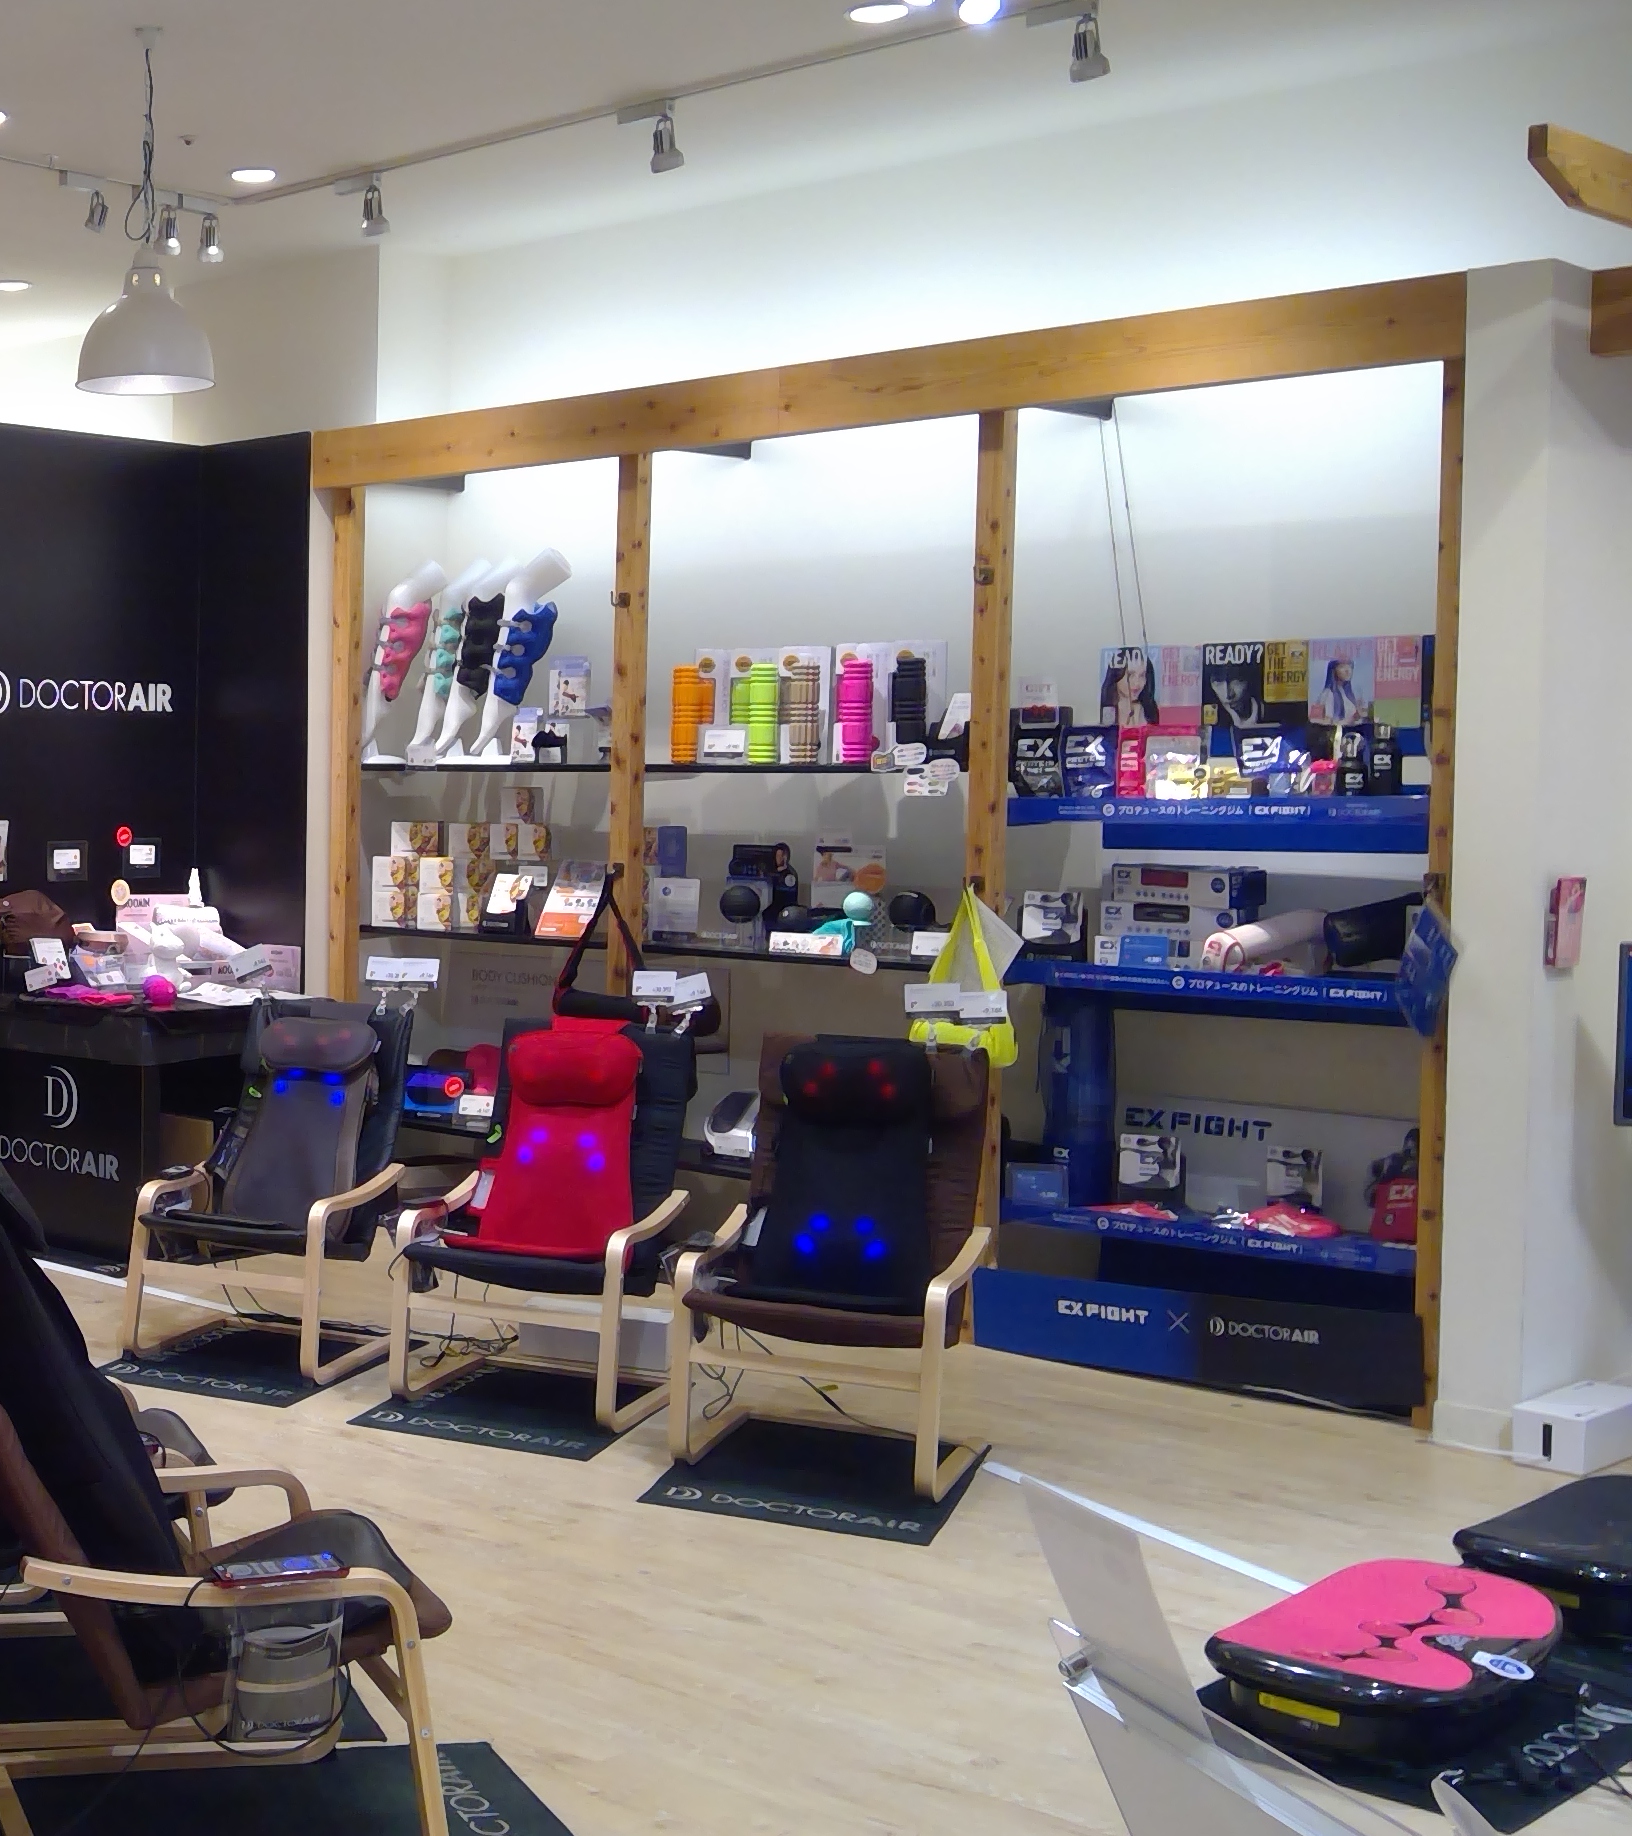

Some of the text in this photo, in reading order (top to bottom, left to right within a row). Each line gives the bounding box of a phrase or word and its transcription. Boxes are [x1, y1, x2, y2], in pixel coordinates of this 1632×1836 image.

[1205, 644, 1263, 665] READY?
[1267, 642, 1286, 656] GET
[1267, 657, 1286, 669] THE
[1266, 670, 1307, 684] ENERGY
[19, 678, 173, 713] DOCTORAIR
[1228, 1321, 1320, 1345] DOCTORAIR
[407, 1415, 587, 1450] DOCTORAIR
[710, 1493, 924, 1533] DOCTORAIR
